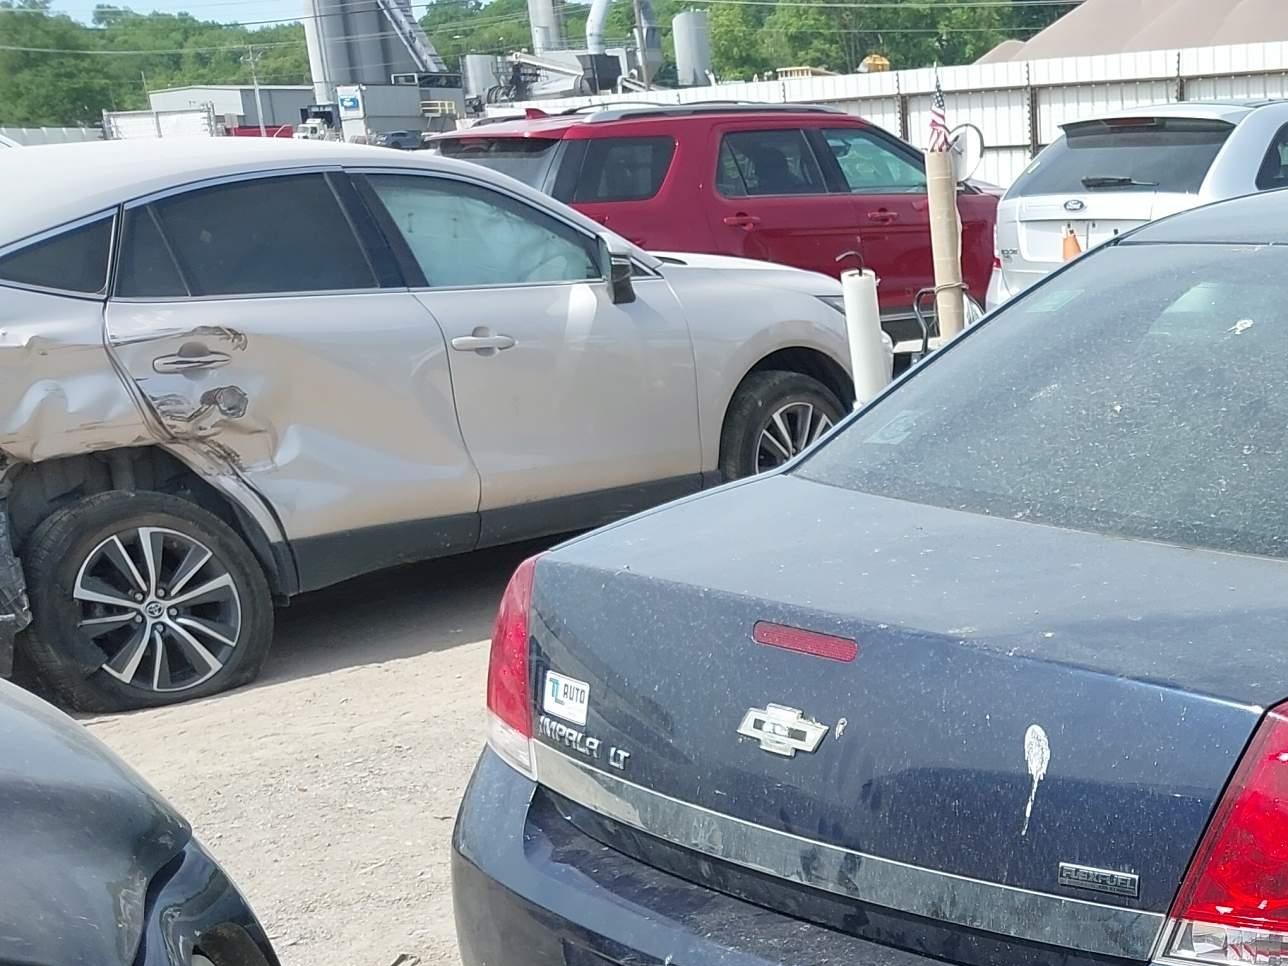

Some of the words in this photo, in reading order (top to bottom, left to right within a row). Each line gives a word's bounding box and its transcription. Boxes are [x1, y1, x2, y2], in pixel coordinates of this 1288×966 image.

[563, 683, 586, 704] AUTO
[539, 715, 602, 758] IMPALA
[608, 746, 631, 770] LT
